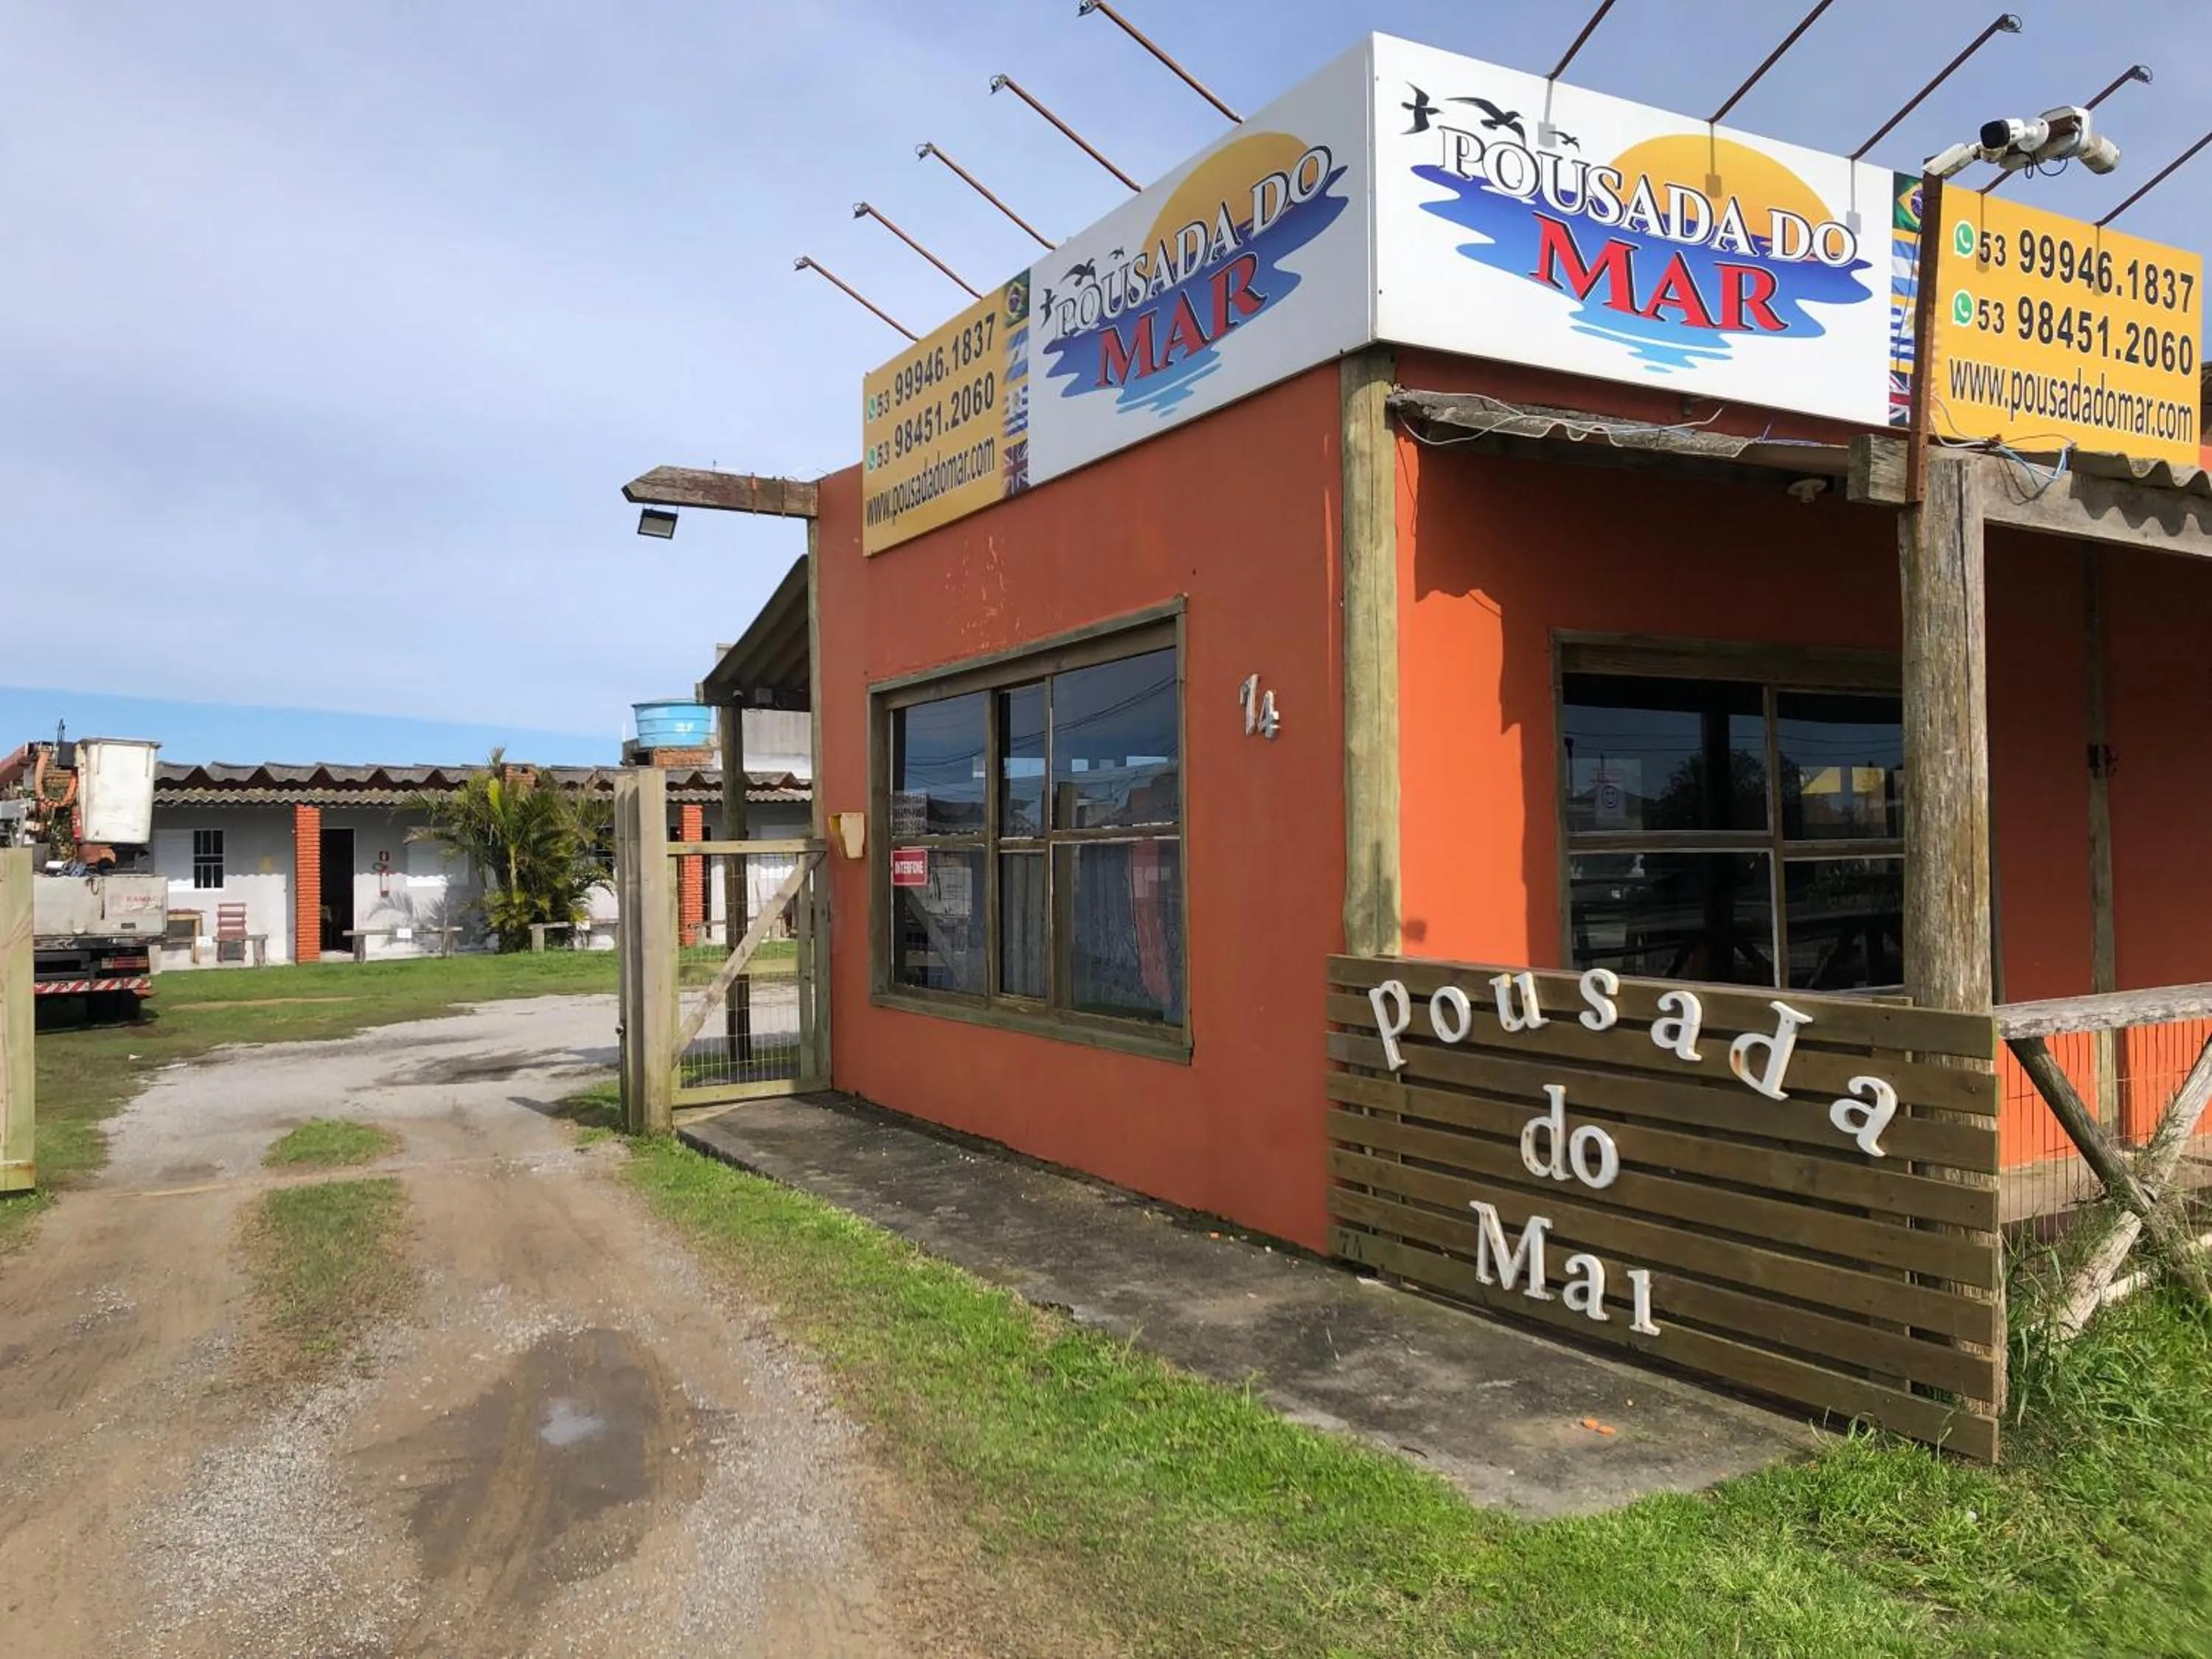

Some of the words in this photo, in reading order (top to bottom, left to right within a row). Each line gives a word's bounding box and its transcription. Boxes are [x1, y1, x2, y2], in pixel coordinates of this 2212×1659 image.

[1053, 201, 1243, 340] POUSADA
[1251, 145, 1332, 237] DO
[1439, 125, 1760, 257] POUSADA
[1767, 207, 1857, 266] DO
[1095, 252, 1268, 389] MAR
[1529, 212, 1790, 332] MAR
[1978, 231, 2006, 267] 53
[2019, 229, 2194, 313] 99946.1837
[877, 389, 890, 418] 53
[895, 312, 995, 406] 99946.1837
[1977, 299, 2005, 334] 53
[2017, 296, 2194, 375] 98451.2060
[877, 441, 890, 468] 53
[894, 372, 995, 459] 98451.2060
[1949, 356, 2193, 443] www.pousadadomar.com
[866, 436, 995, 527] www.pousadadomar.com
[1368, 968, 1899, 1157] pousada
[1520, 1083, 1620, 1189] do
